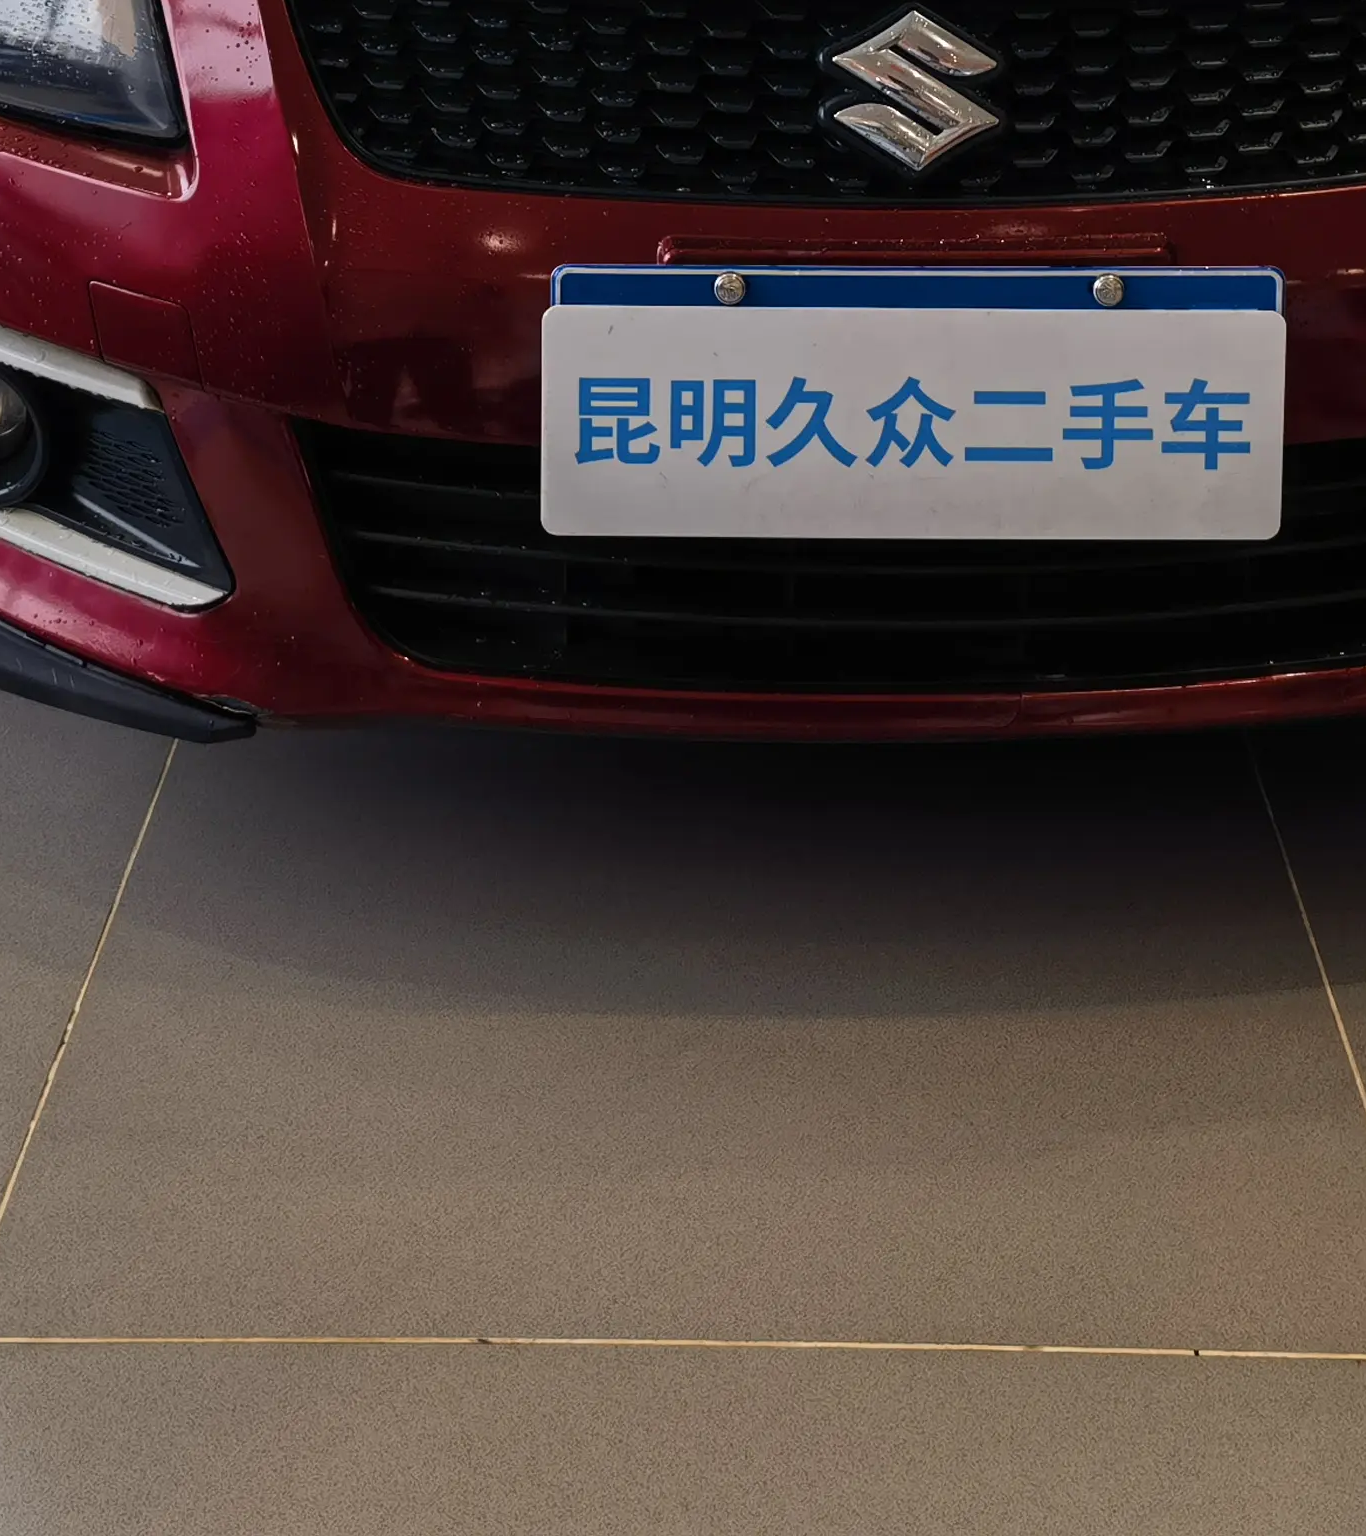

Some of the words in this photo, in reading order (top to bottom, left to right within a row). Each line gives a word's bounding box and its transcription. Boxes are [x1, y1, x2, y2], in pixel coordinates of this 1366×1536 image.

[574, 376, 1254, 471] 昆明久众二手车
